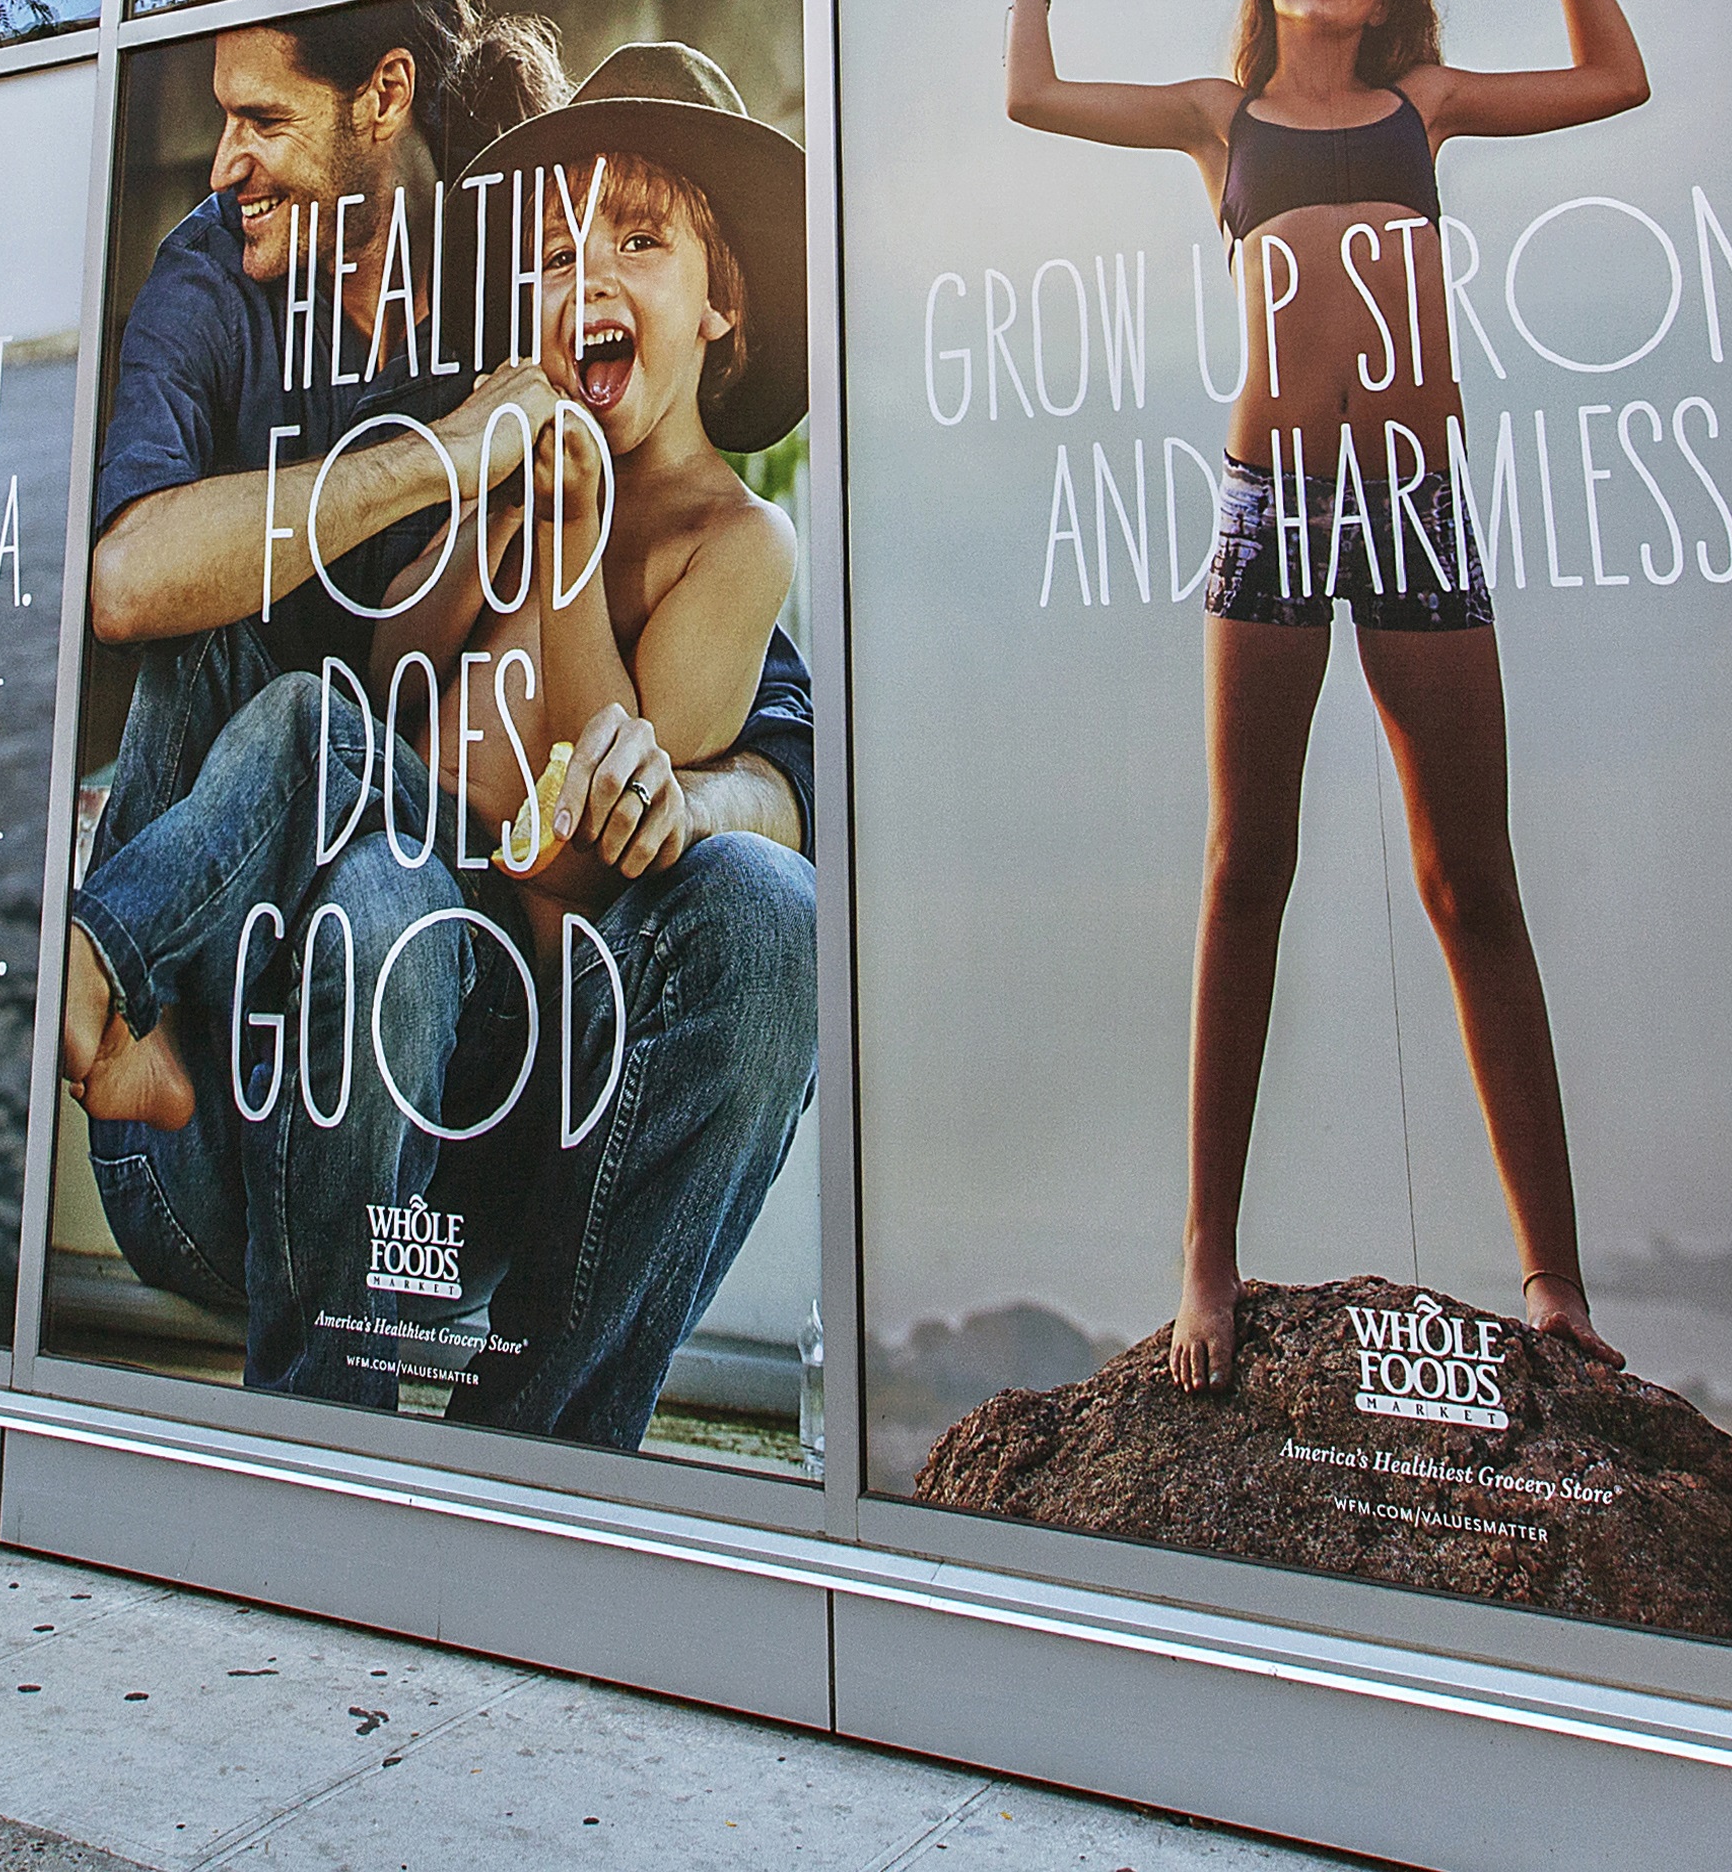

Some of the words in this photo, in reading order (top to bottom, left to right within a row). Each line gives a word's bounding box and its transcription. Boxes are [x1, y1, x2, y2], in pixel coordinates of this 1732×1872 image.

[283, 156, 607, 393] HEALTHY
[922, 249, 1148, 427] GROW
[1192, 233, 1300, 404] UP
[261, 399, 616, 624] FOOD
[1039, 436, 1223, 607] AND
[316, 648, 541, 873] DOES
[231, 901, 627, 1150] GOOD
[366, 1194, 465, 1248] WHOLE
[370, 1239, 459, 1281] FOODS
[373, 1275, 456, 1296] MARKET
[314, 1310, 371, 1333] America's
[373, 1317, 436, 1343] Healthiest
[438, 1327, 487, 1354] Grocery
[1345, 1293, 1507, 1364] WHOLE
[346, 1355, 480, 1386] WFM.COM/VALUESMATTER
[1357, 1349, 1502, 1408] FOODS
[1366, 1396, 1498, 1426] MARKET
[1279, 1438, 1368, 1471] America's
[1372, 1450, 1474, 1485] Healthiest
[1478, 1466, 1556, 1502] Grocery
[1333, 1496, 1549, 1544] WFM.COM/VALUESMATTER
